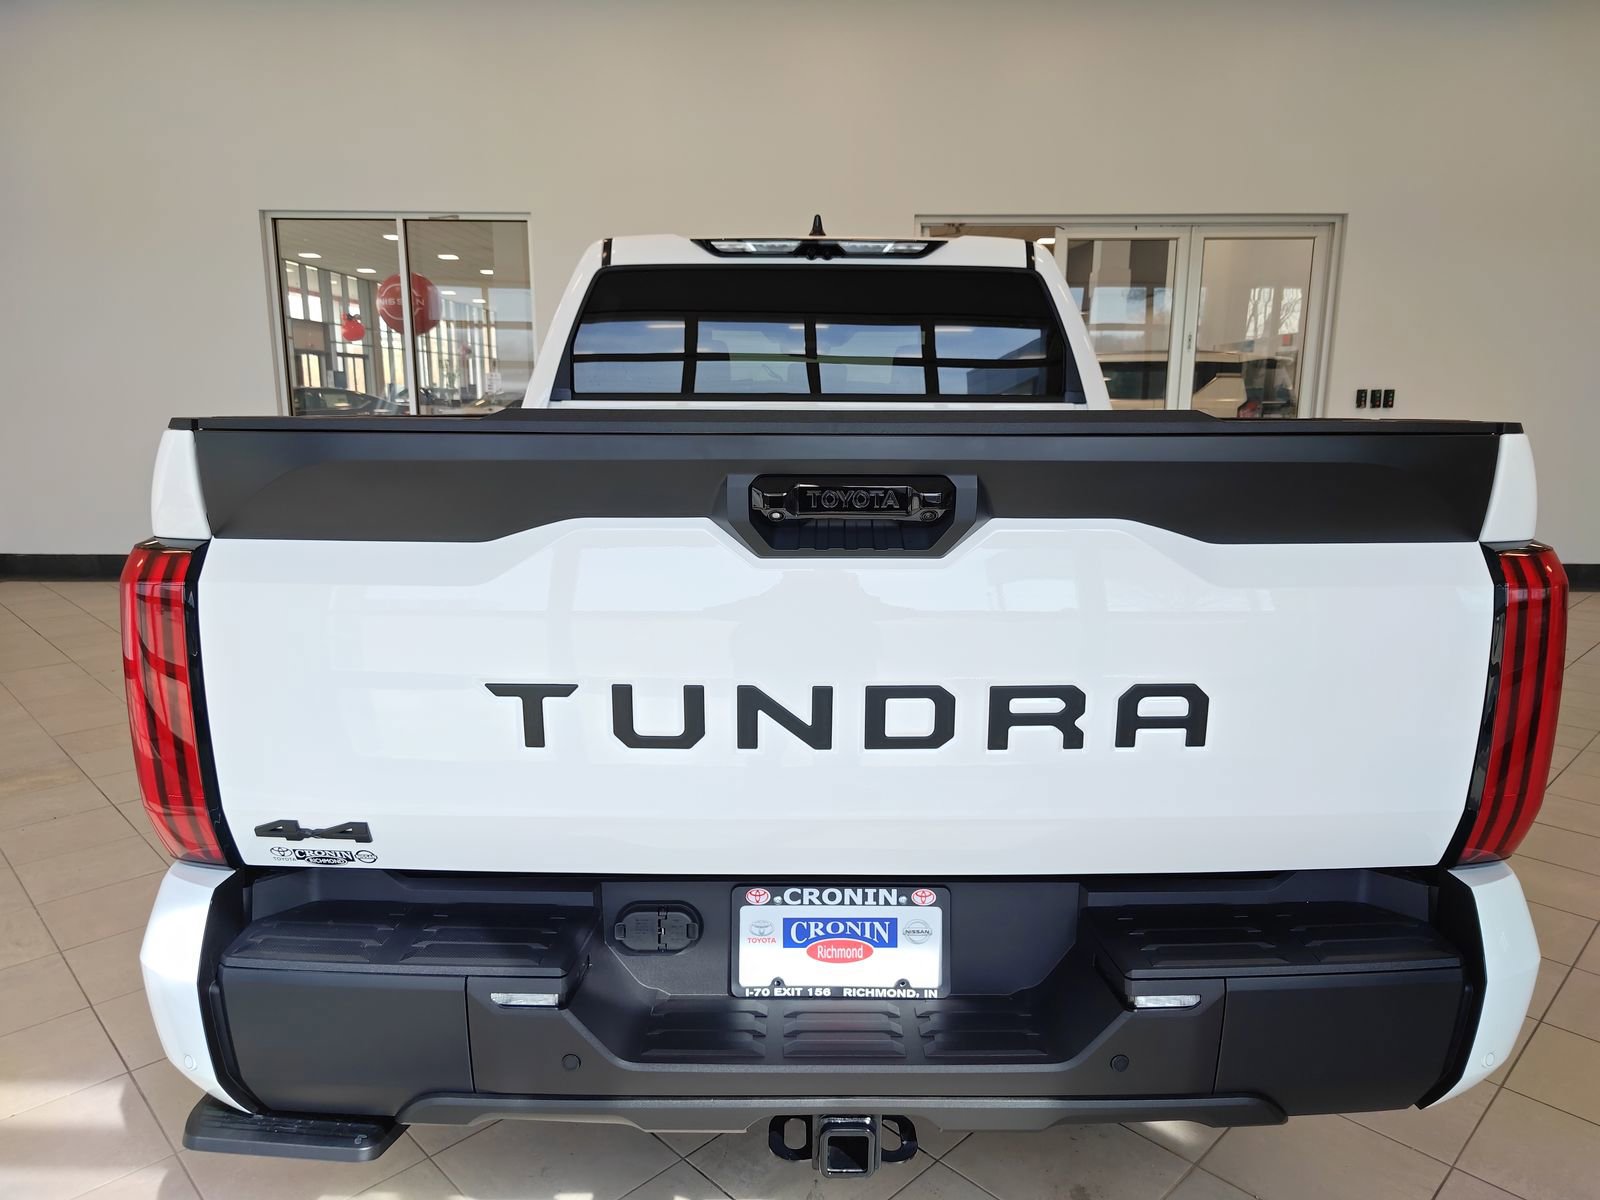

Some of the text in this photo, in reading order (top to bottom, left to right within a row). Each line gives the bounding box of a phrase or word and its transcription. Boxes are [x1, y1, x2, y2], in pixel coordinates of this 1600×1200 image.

[379, 297, 425, 306] NISSN
[807, 490, 900, 509] TOYOTA
[485, 683, 1210, 750] TUNDRA
[295, 849, 353, 861] CRONIN
[783, 888, 898, 906] CRONIN
[790, 921, 890, 944] CRONIN
[817, 945, 863, 959] Richmond
[745, 988, 831, 997] I-70 EXIT 156
[843, 988, 938, 998] RICHMOND, IN
